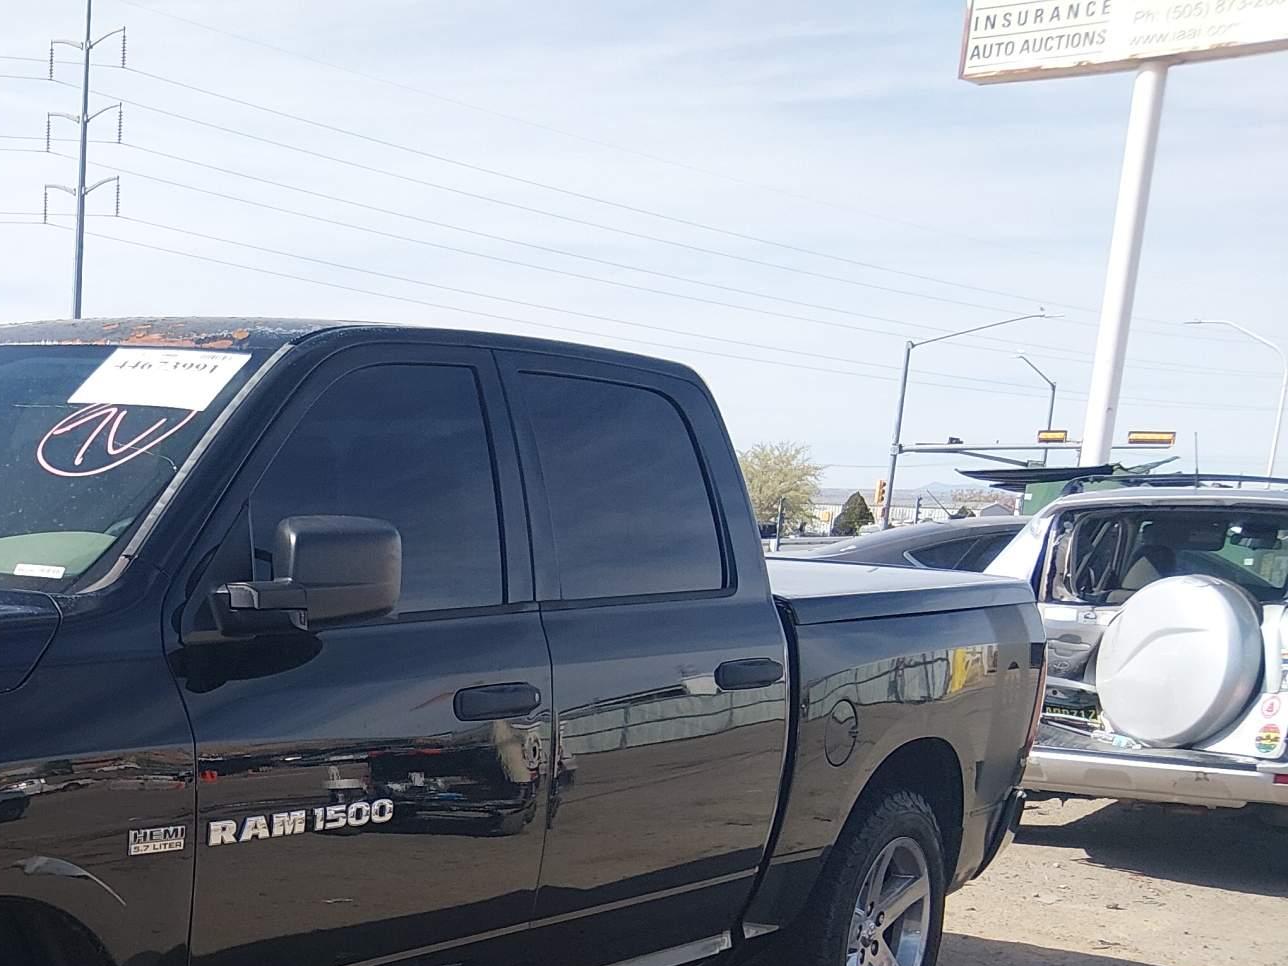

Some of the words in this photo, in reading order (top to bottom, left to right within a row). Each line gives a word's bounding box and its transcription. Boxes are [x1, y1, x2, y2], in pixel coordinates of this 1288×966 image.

[974, 0, 1112, 31] INSURANCE
[970, 41, 1015, 60] AUTO
[1019, 29, 1108, 55] AUCTIONS
[131, 827, 186, 844] HEMI
[208, 810, 307, 846] RAM
[313, 798, 394, 832] 1500
[133, 844, 150, 853] 5.7
[152, 841, 182, 851] LITER
